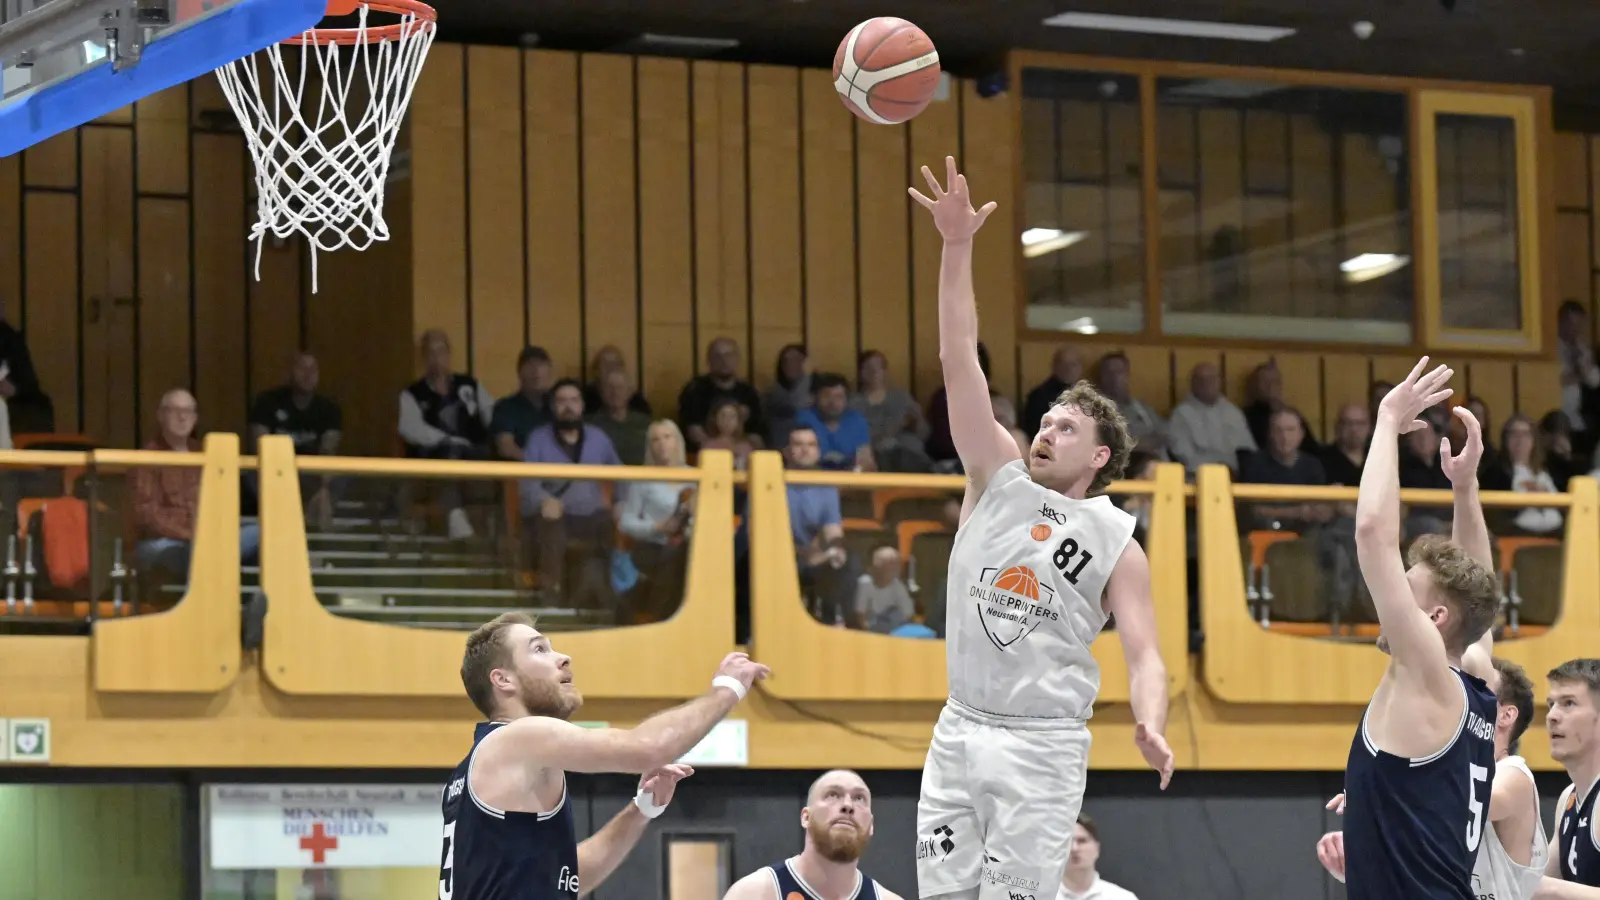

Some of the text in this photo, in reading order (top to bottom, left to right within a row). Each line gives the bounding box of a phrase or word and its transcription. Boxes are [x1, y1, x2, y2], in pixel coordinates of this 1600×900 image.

[1052, 538, 1093, 586] 81
[969, 586, 1058, 621] ONLINEPRINTERS
[283, 807, 375, 819] MENSCHEN
[1466, 762, 1488, 852] 5
